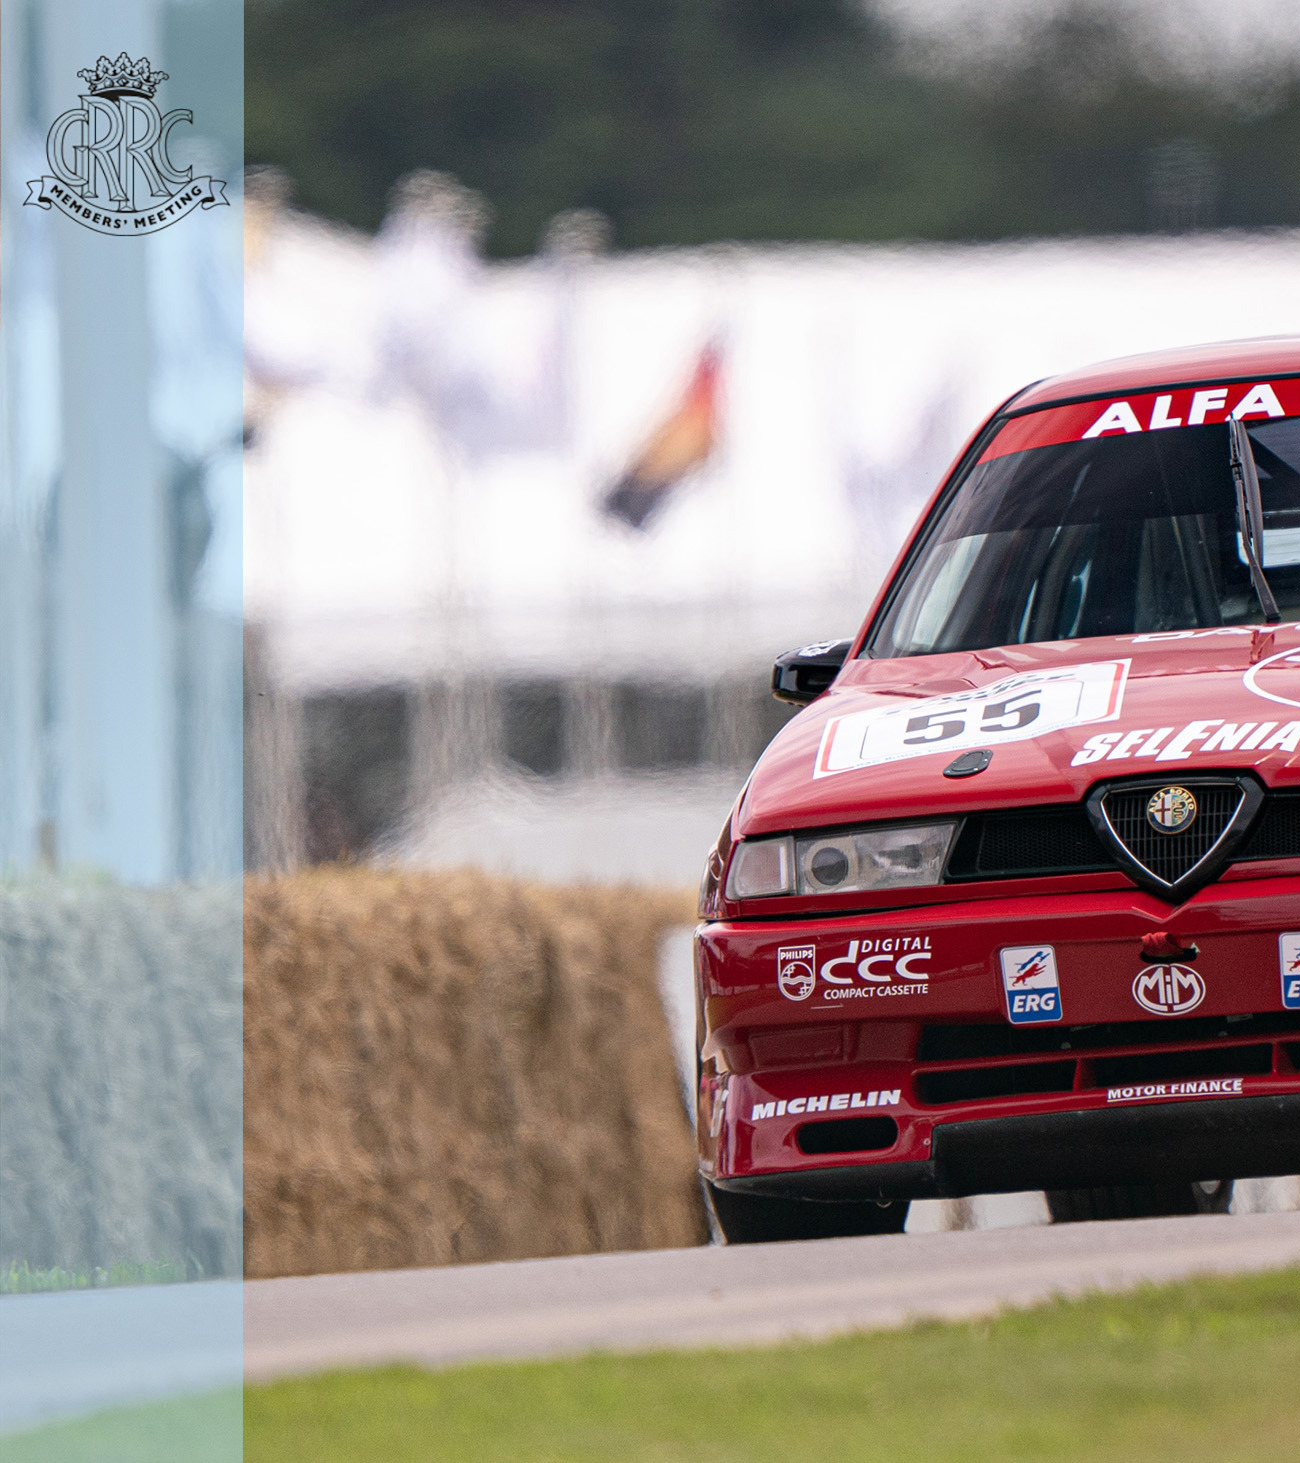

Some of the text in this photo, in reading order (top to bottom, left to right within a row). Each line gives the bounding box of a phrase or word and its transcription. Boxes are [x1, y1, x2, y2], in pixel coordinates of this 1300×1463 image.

[1082, 383, 1286, 439] ALFA
[903, 689, 1042, 745] 55
[1148, 788, 1195, 813] ALFA ROMEO
[780, 949, 814, 961] PHILIPS
[861, 936, 932, 954] DIGITAL
[820, 940, 931, 984] dcc
[823, 983, 929, 1000] COMPACT CASSETTE
[1012, 993, 1056, 1014] ERG
[1107, 1078, 1243, 1100] MOTOR FINANCE
[751, 1089, 902, 1122] MICHELIN
